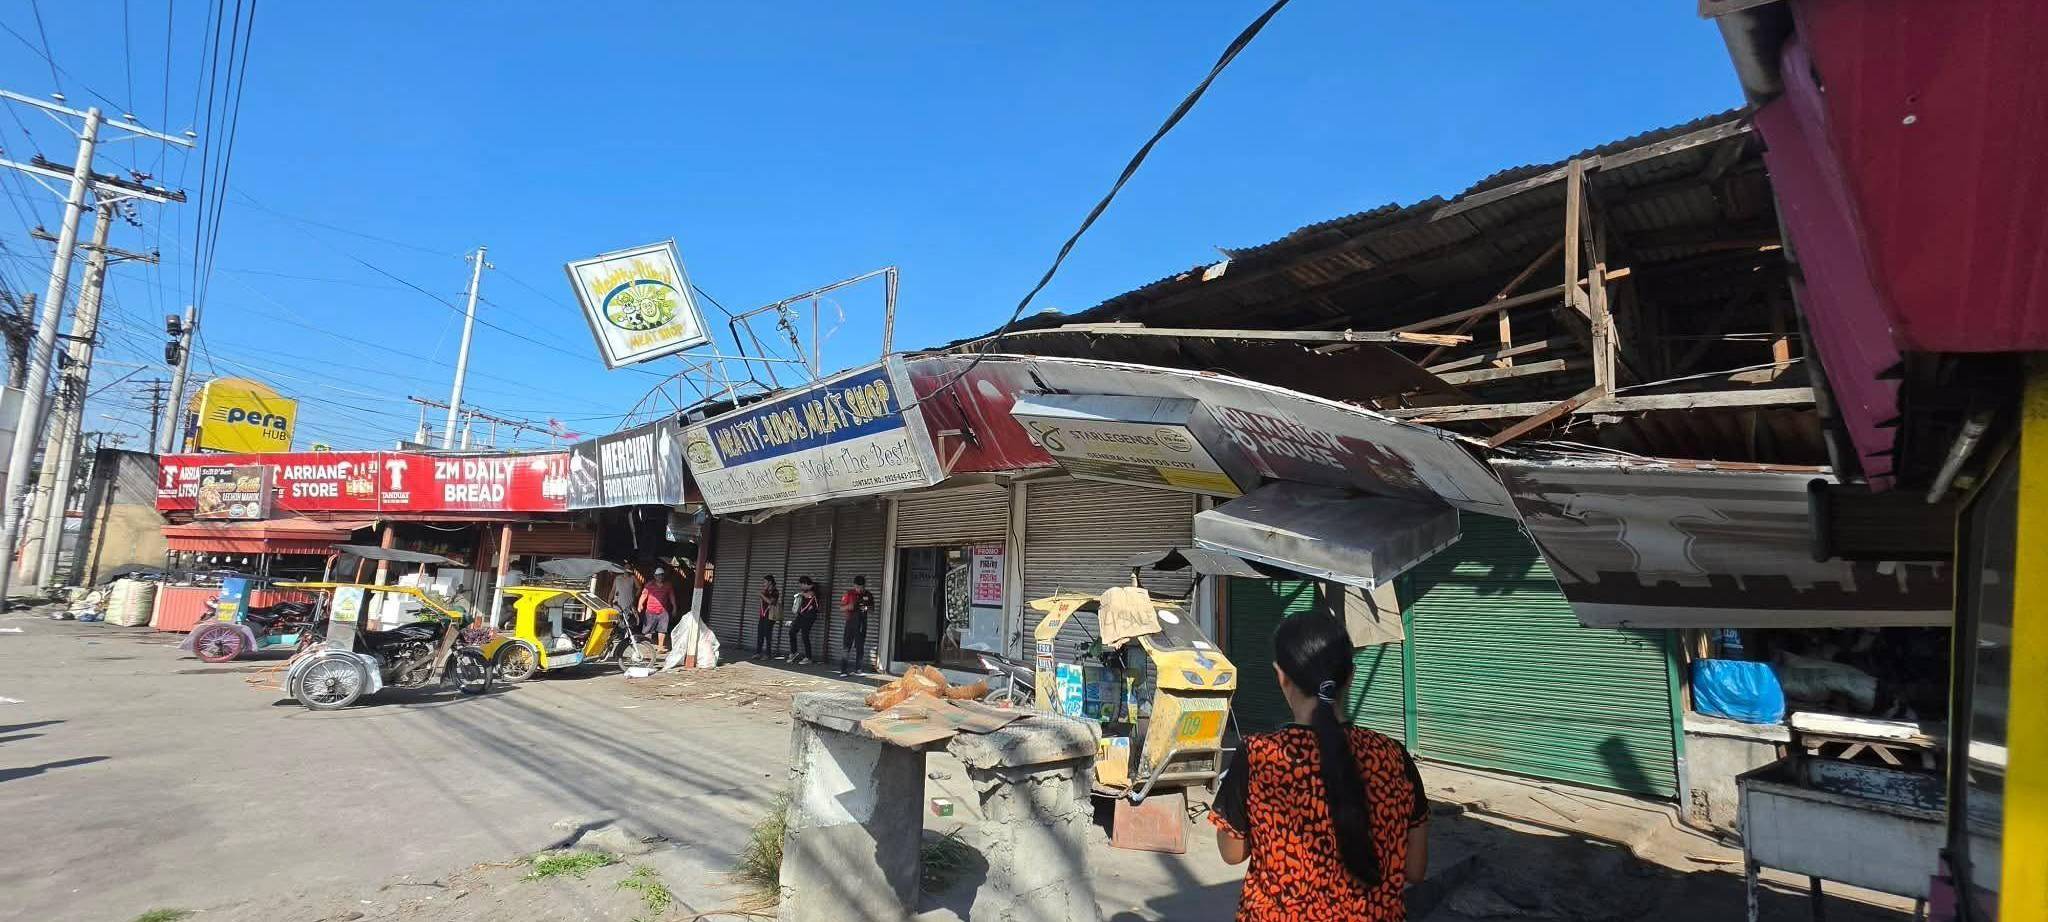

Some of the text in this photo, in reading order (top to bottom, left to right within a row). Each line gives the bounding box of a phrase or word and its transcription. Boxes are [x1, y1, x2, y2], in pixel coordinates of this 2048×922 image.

[801, 393, 849, 440] MEAT
[844, 379, 890, 426] SHOP
[227, 407, 287, 431] pera
[262, 428, 287, 441] HUB
[1069, 430, 1159, 446] STARLEGENDS
[601, 433, 654, 476] MERCURY
[1252, 433, 1348, 470] HOUSE
[284, 464, 347, 480] ARRIANE
[434, 459, 515, 480] ZM DAILY
[1171, 460, 1196, 469] CITY
[179, 467, 200, 480] ARRIA
[179, 483, 199, 497] LITSO
[292, 482, 339, 497] STORE
[444, 484, 505, 502] BREAD
[603, 478, 623, 498] FOOD
